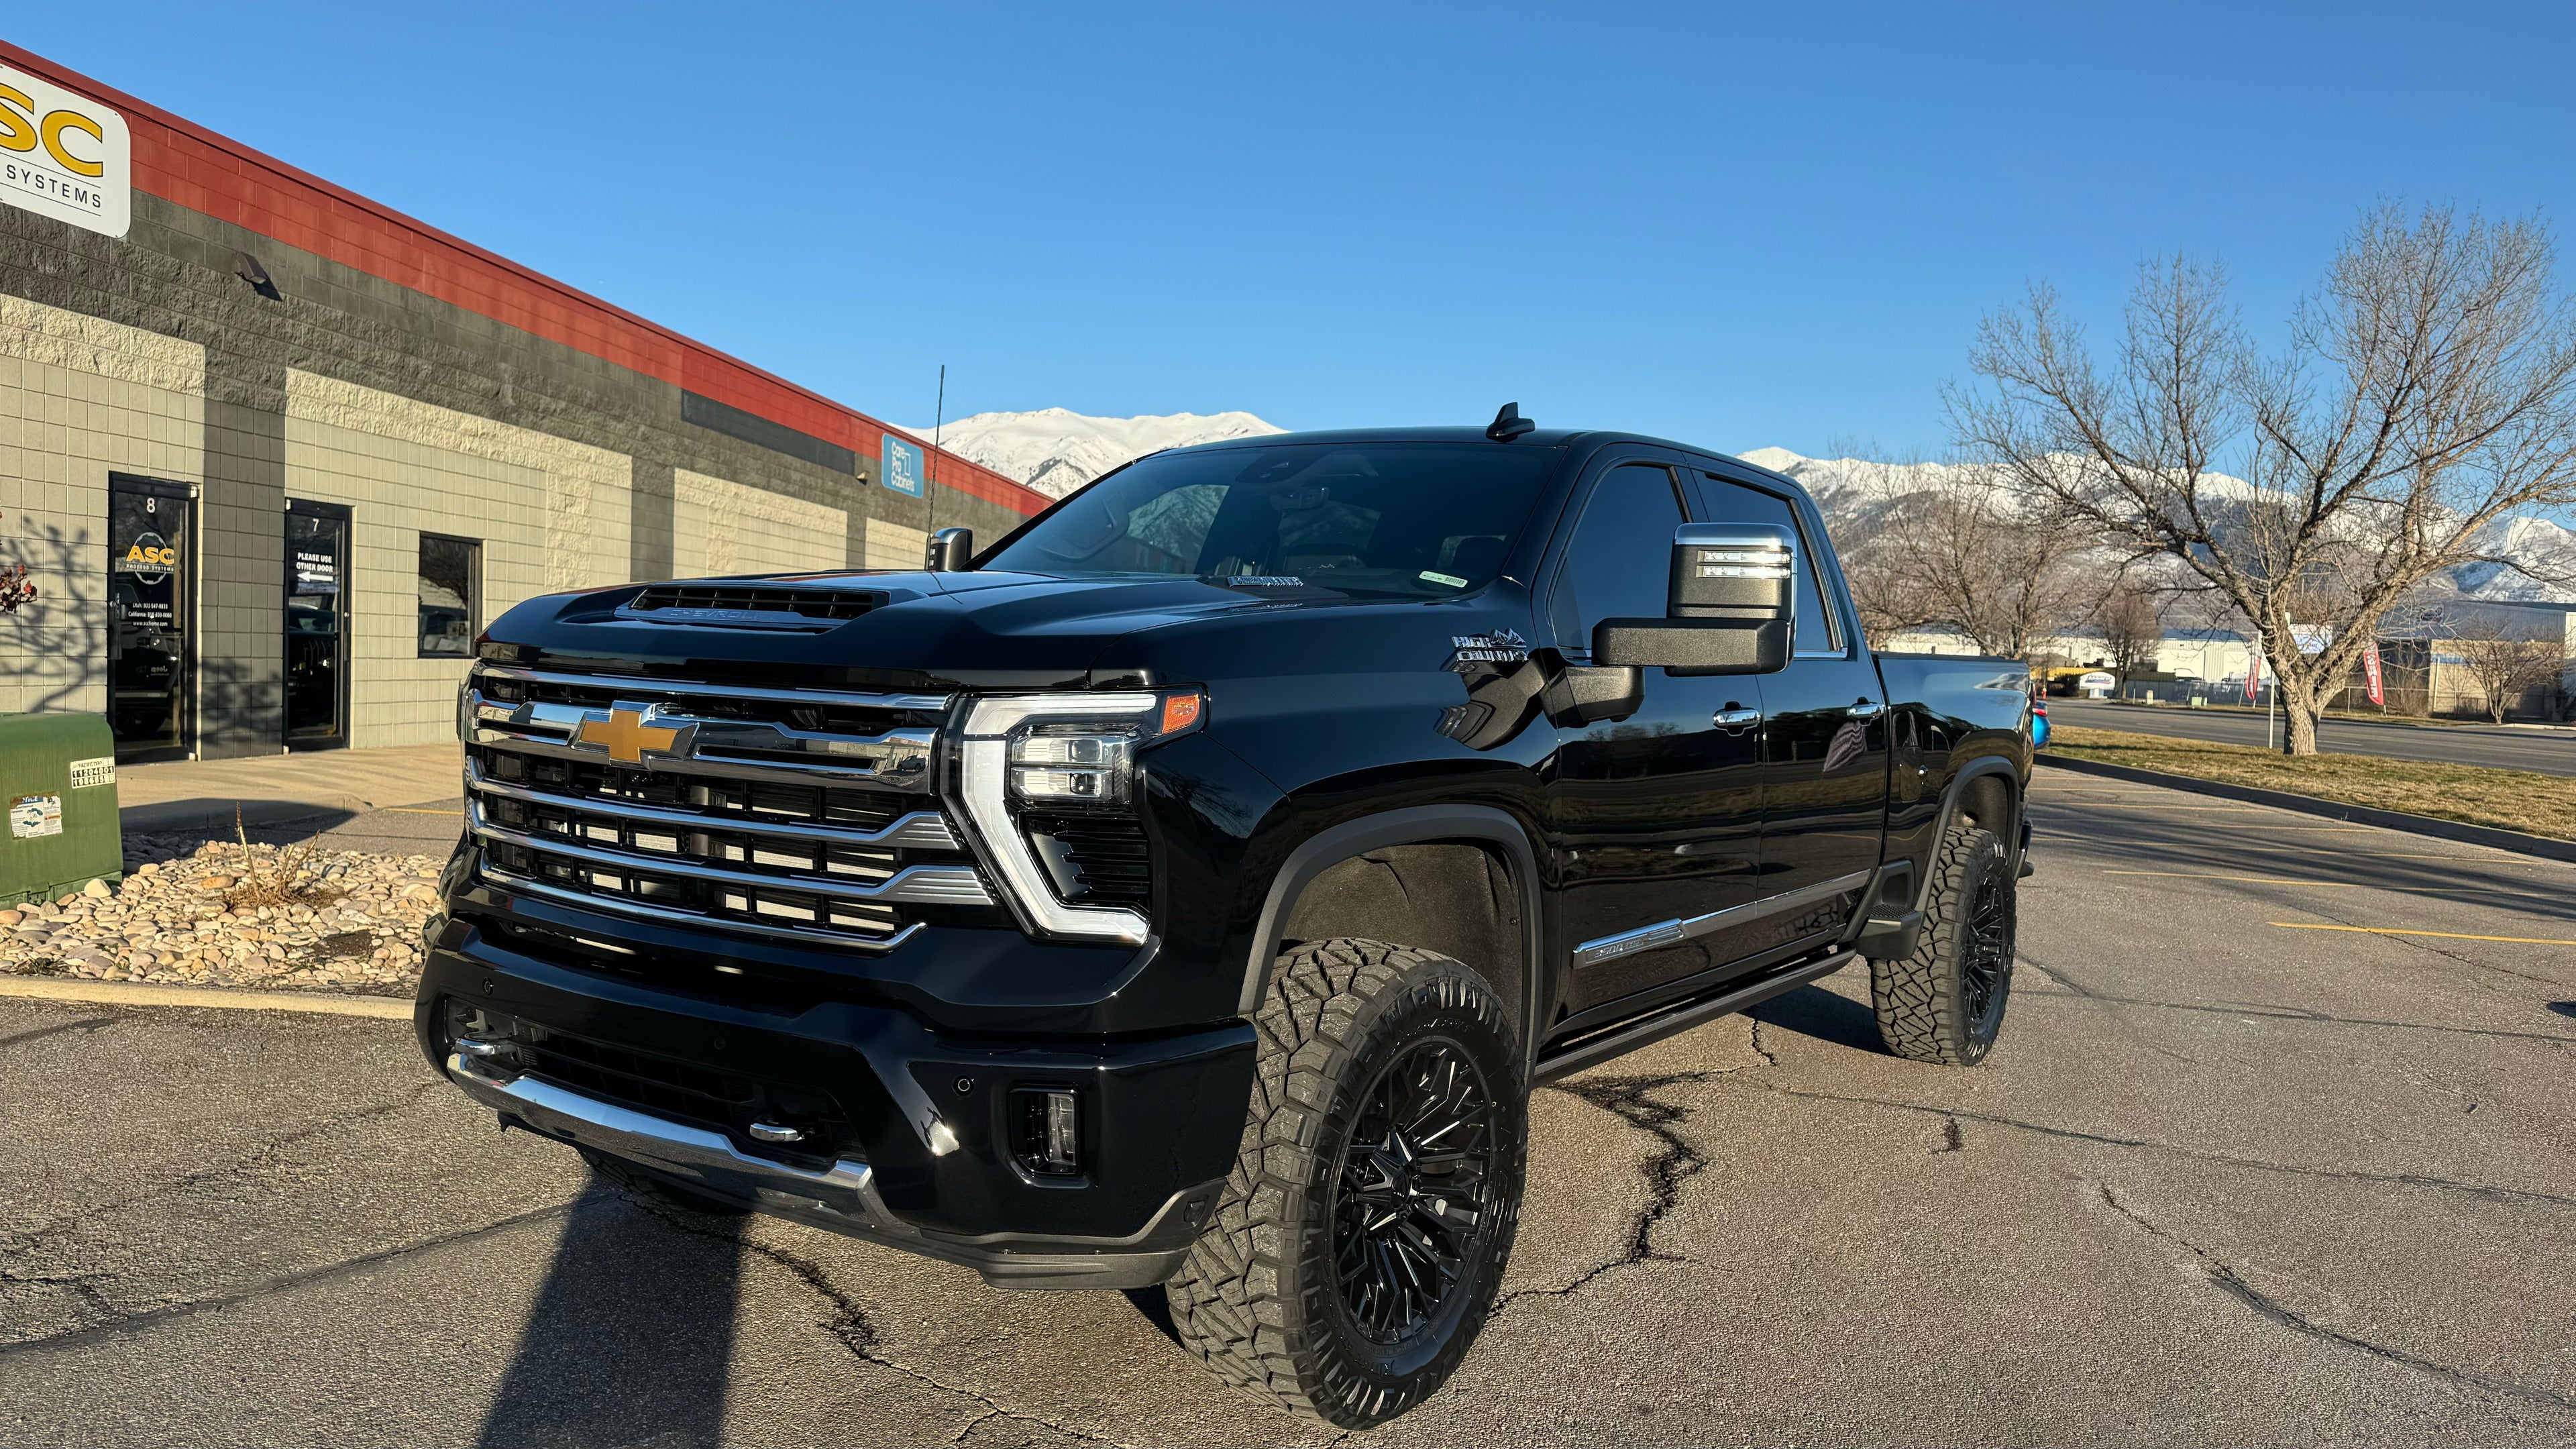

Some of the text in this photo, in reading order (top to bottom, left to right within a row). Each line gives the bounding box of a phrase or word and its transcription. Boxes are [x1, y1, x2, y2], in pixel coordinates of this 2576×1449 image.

[7, 164, 101, 209] SYSTEMS
[146, 497, 156, 514] 8
[313, 519, 319, 532] 7
[126, 545, 174, 565] ASC
[297, 552, 332, 564] PLEASE USE
[296, 561, 333, 573] OTHER DOOR
[670, 609, 779, 621] CHEVROLET
[1451, 636, 1492, 649] HIGH
[1456, 650, 1529, 662] COUNTRY
